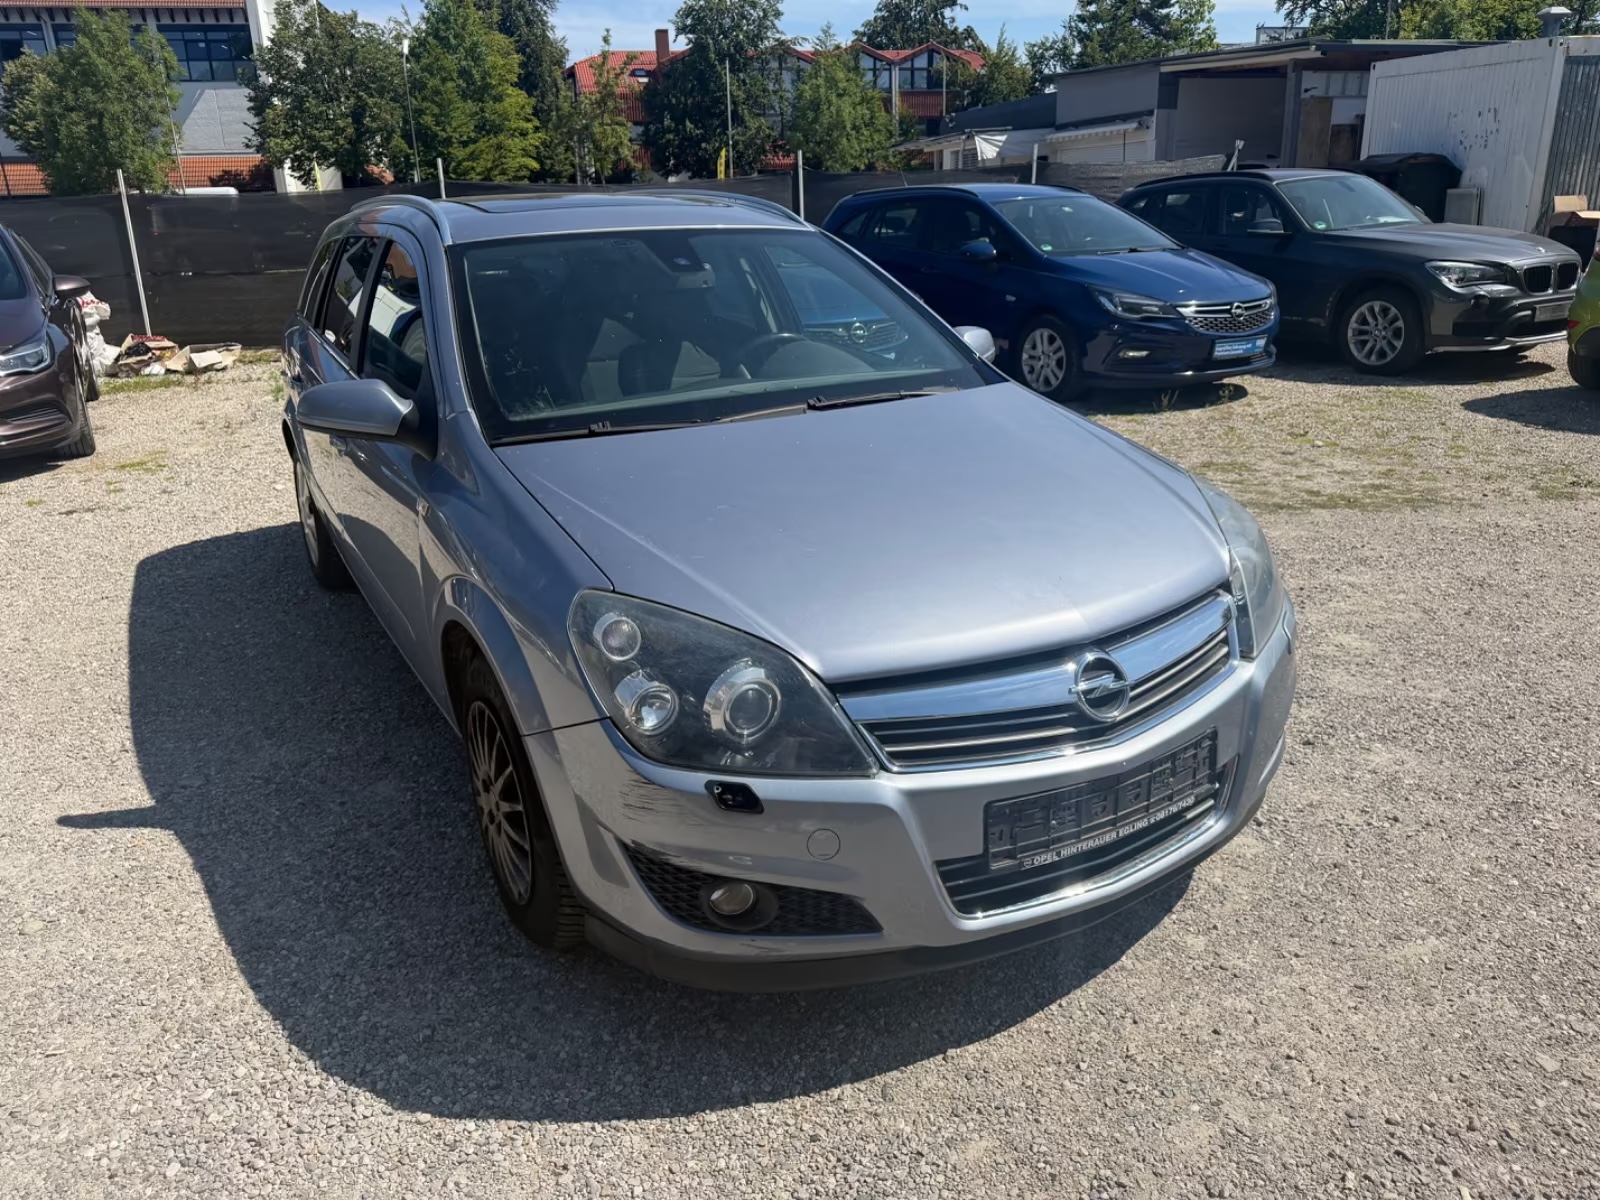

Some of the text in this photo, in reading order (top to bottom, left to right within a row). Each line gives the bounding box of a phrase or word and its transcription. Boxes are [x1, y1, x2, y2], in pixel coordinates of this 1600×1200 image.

[1033, 851, 1059, 865] OPEL
[1060, 831, 1117, 857] HINTERAUER
[1118, 818, 1149, 838] EGLING
